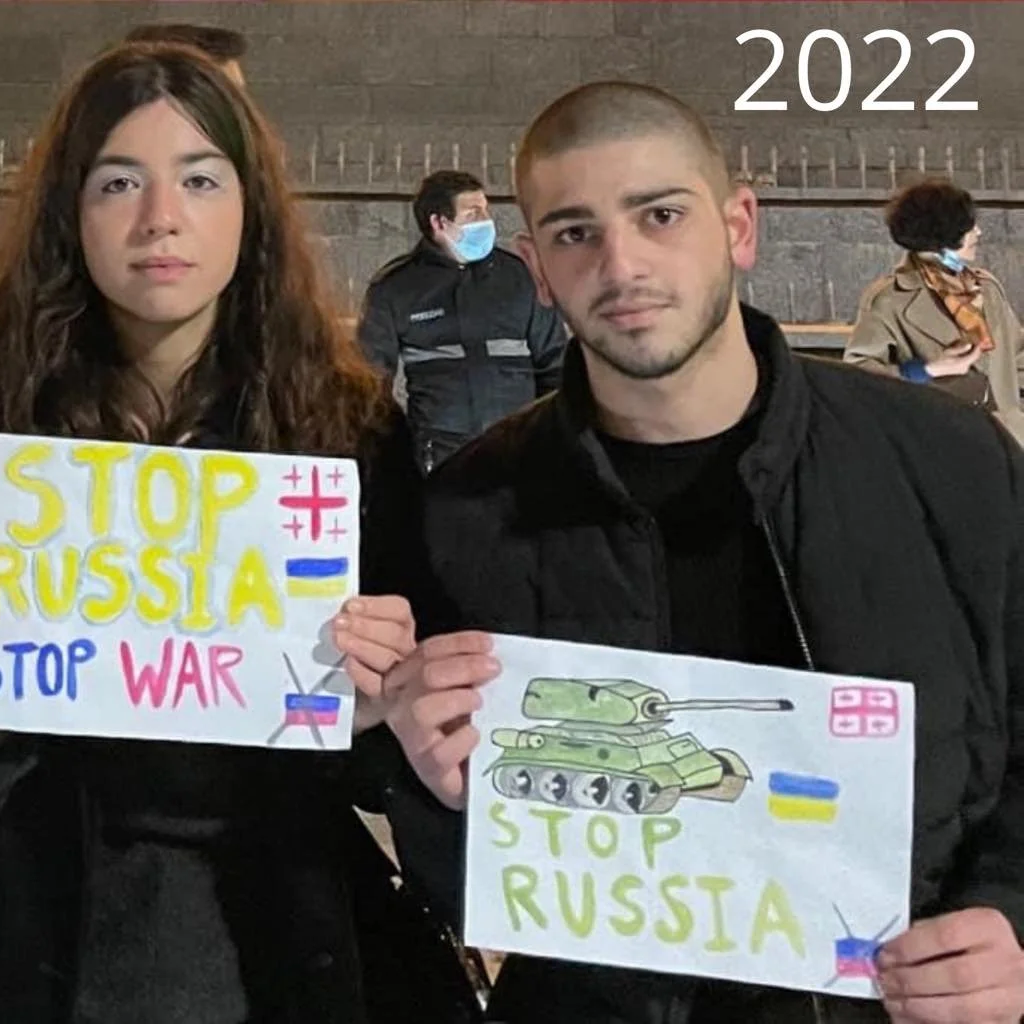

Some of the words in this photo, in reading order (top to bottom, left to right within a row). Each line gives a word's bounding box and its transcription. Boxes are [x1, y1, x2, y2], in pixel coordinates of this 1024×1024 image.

[4, 441, 260, 556] STOP
[119, 636, 247, 711] WAR
[489, 802, 683, 870] STOP
[501, 864, 808, 959] RUSSIA
